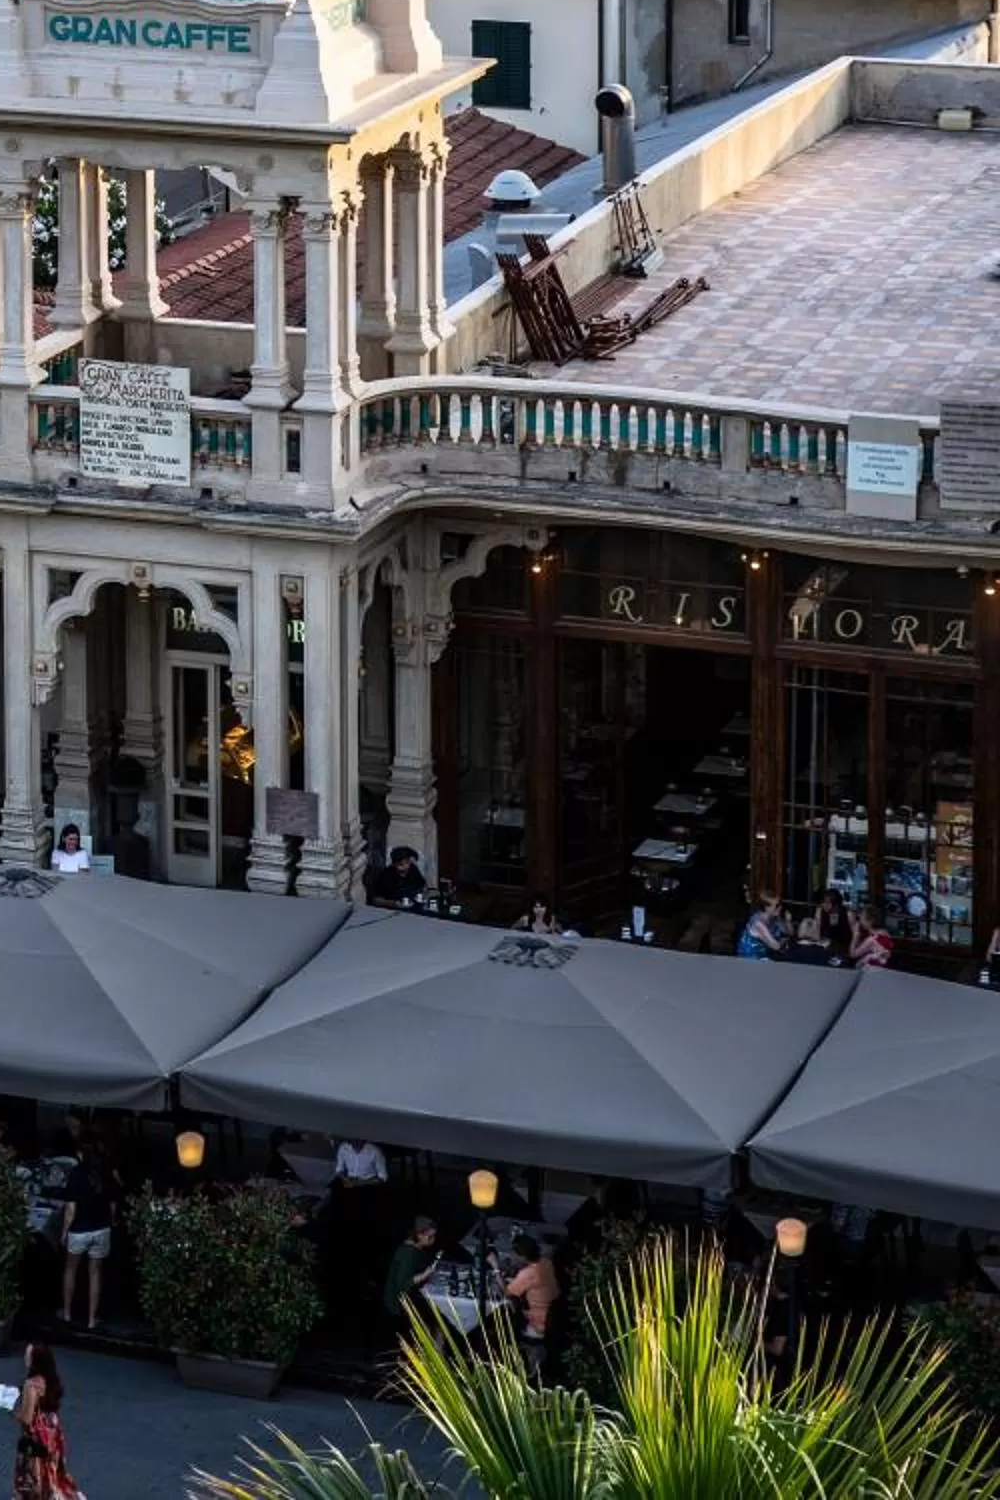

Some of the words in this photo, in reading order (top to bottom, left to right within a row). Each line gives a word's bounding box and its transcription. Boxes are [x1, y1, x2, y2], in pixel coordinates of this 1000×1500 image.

[50, 15, 137, 46] GRAN
[142, 20, 251, 53] CAFFE
[172, 606, 212, 633] BA
